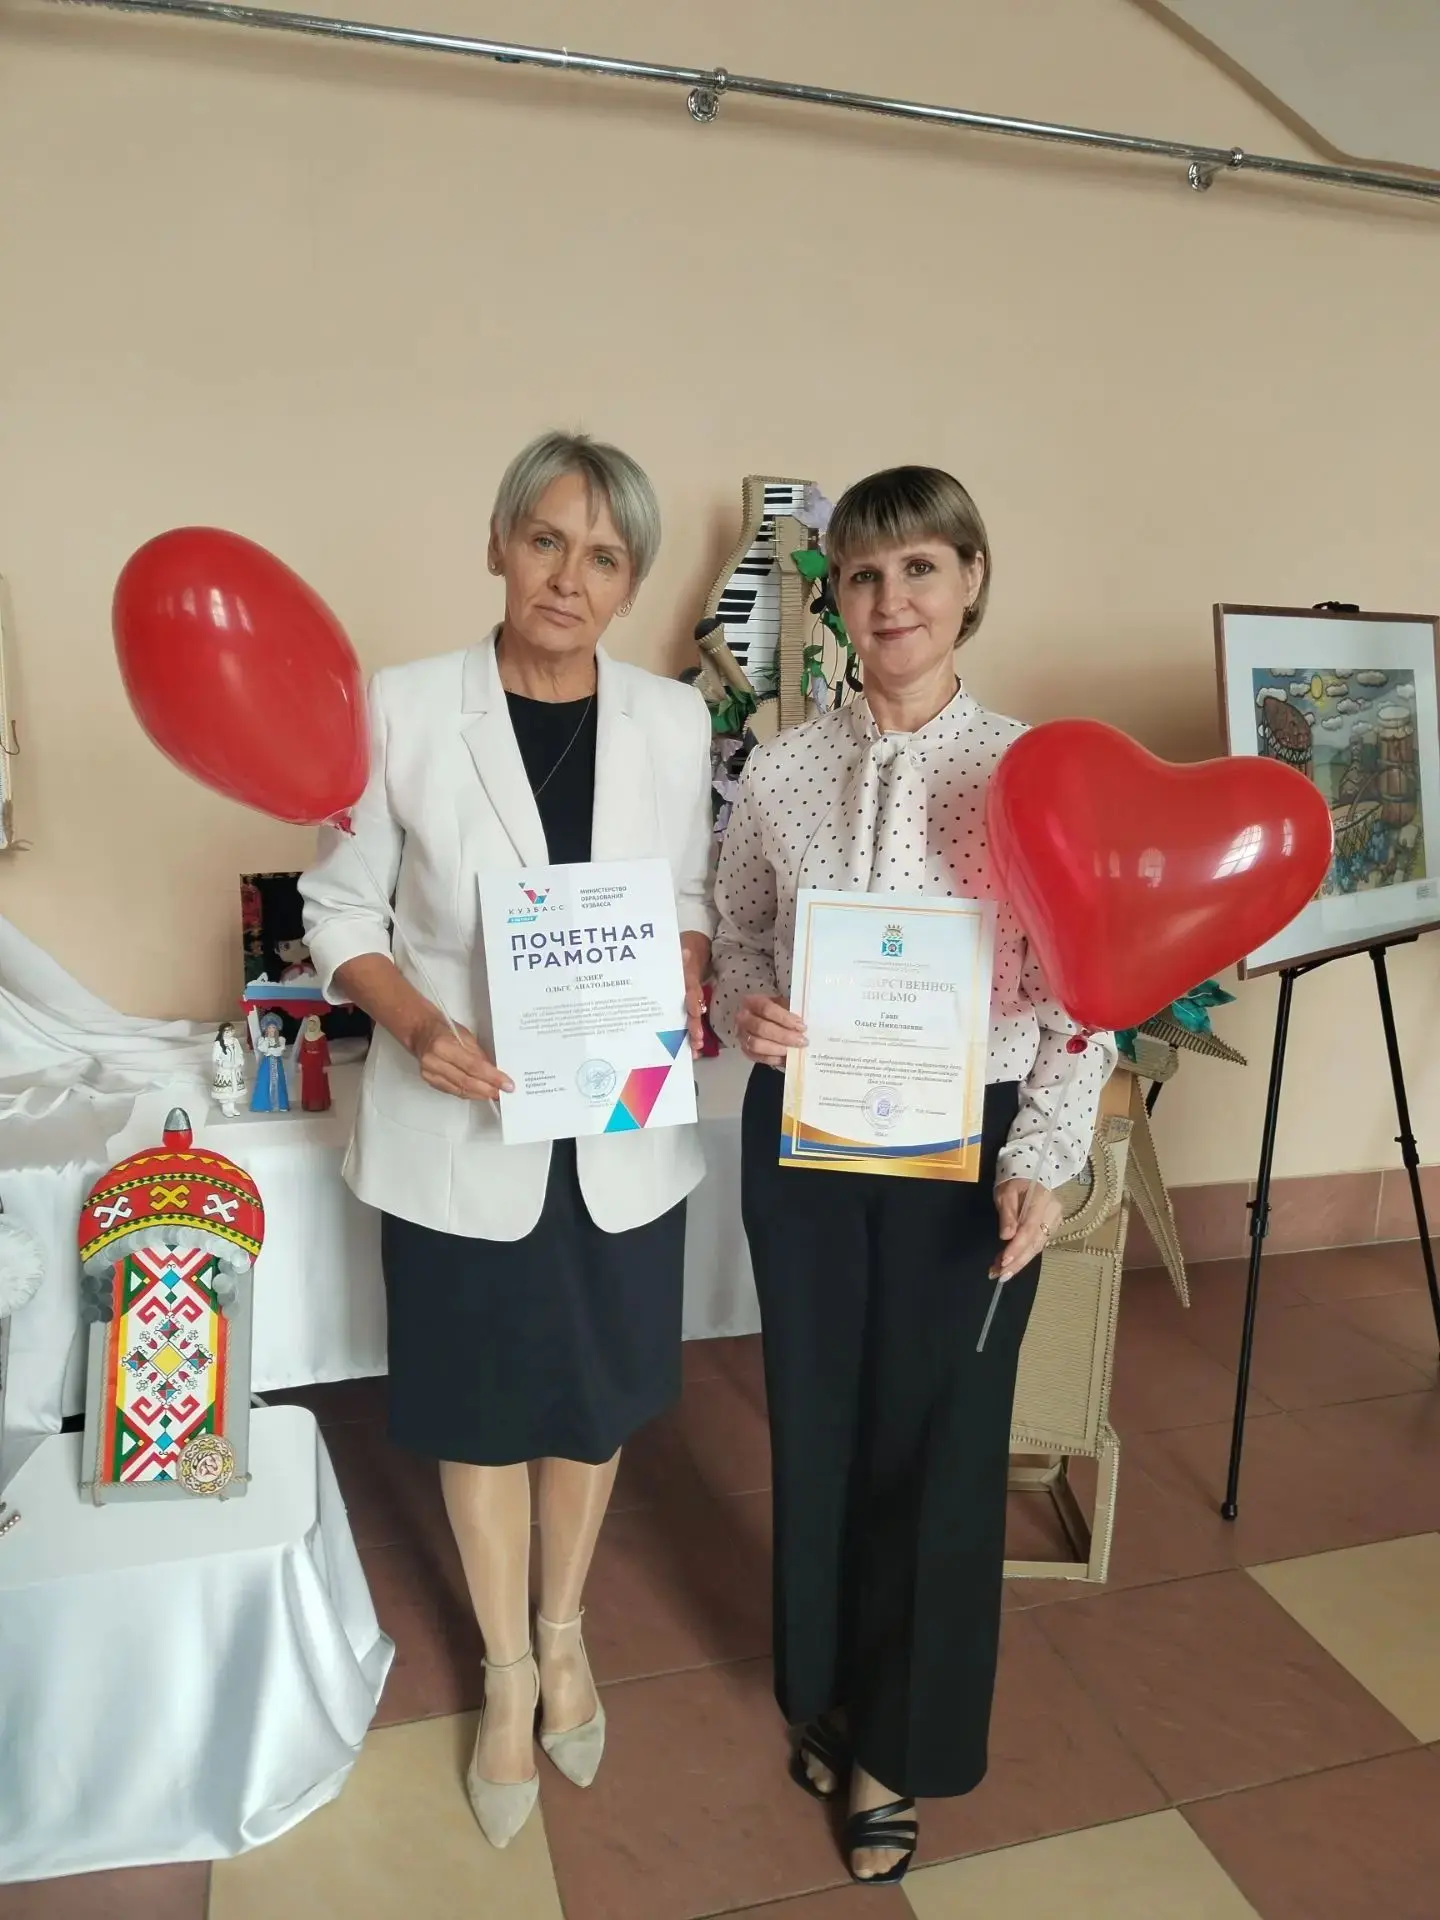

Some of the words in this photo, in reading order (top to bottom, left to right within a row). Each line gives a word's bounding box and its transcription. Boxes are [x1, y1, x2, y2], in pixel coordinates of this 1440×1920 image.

[580, 886, 627, 894] МИНИСТЕРСТВО
[580, 893, 624, 902] ОБРАЗОВАНИЯ
[508, 904, 565, 915] КУЗБАСС
[581, 901, 612, 909] КУЗБАССА
[511, 922, 655, 951] ПОЧЕТНАЯ
[512, 944, 637, 971] ГРАМОТА
[545, 984, 571, 993] ОЛЬГЕ
[823, 976, 958, 993] АРСТВЕННОЕ
[860, 990, 918, 1003] ПИСЬМО
[854, 1019, 877, 1028] Ольге
[878, 1021, 923, 1031] Николаевне
